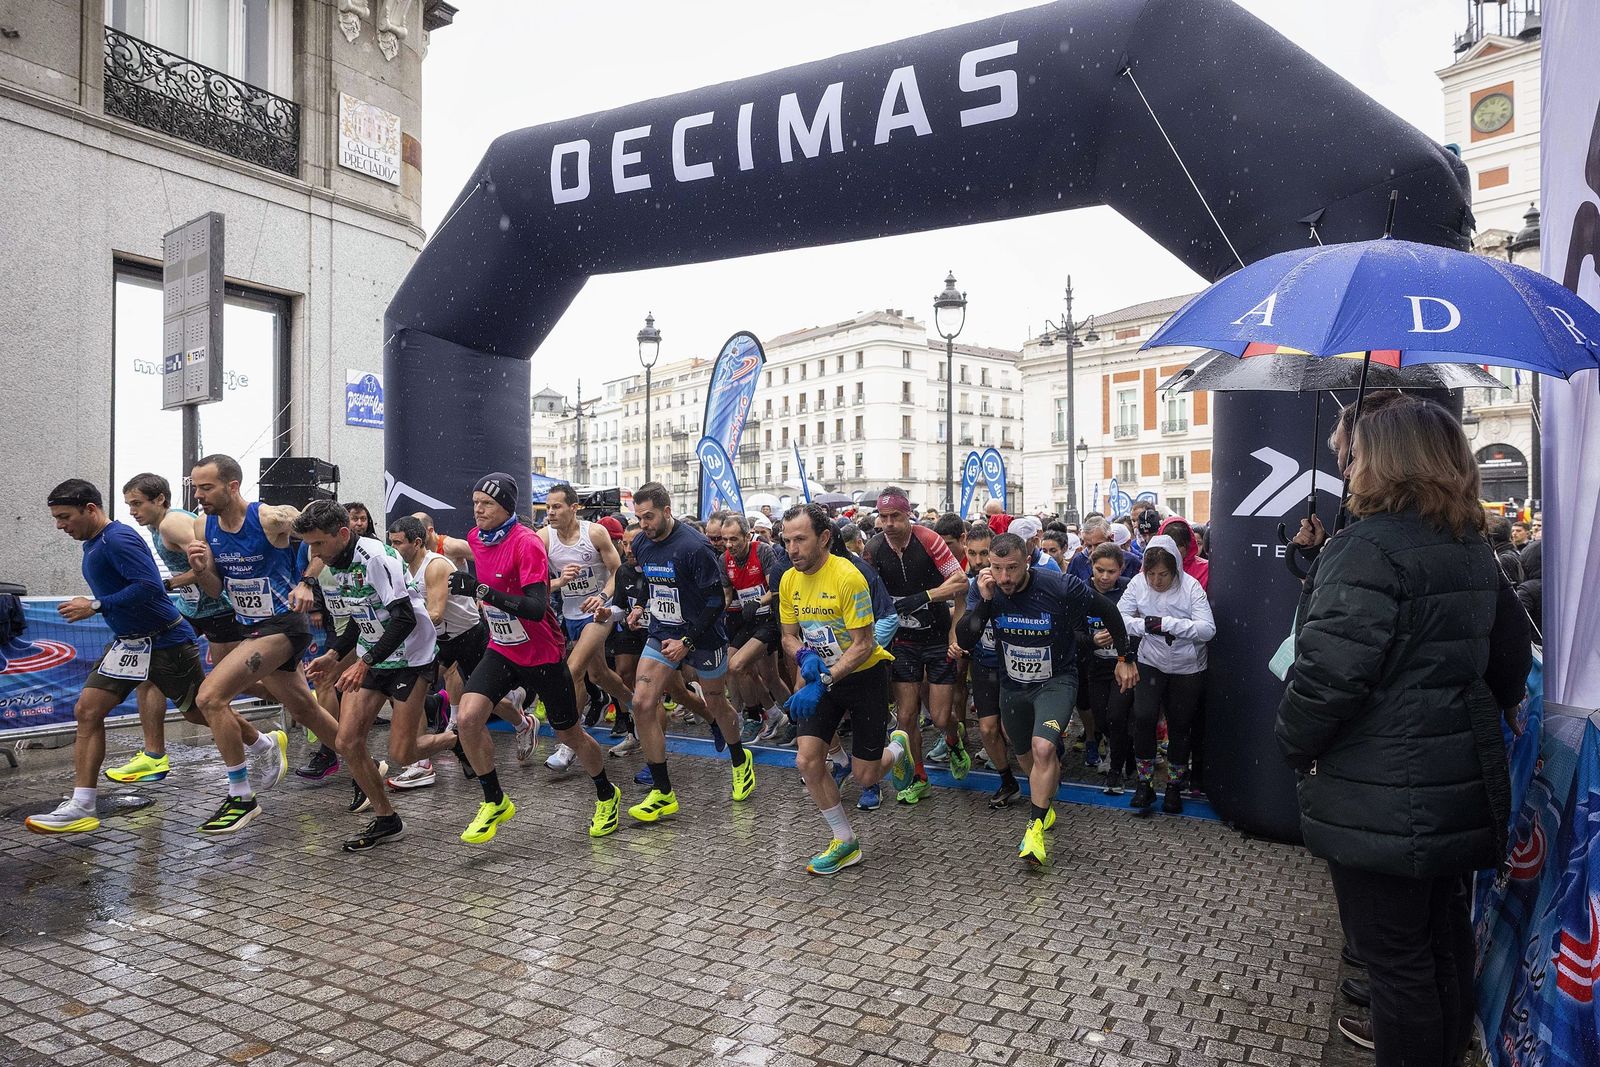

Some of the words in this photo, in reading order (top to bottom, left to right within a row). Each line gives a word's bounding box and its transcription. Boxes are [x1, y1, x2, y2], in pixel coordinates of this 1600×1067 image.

[550, 39, 1019, 205] DECIMAS
[347, 140, 380, 161] CALLE
[384, 155, 393, 165] DE
[344, 151, 397, 180] PRECIADOS
[192, 349, 205, 361] TEVA
[567, 580, 590, 591] 1845
[234, 595, 262, 608] 1823
[657, 600, 676, 614] 2178
[1007, 616, 1050, 625] BOMBEROS
[1003, 628, 1050, 636] DECIMAS
[118, 654, 139, 667] 978
[1010, 659, 1042, 673] 2622
